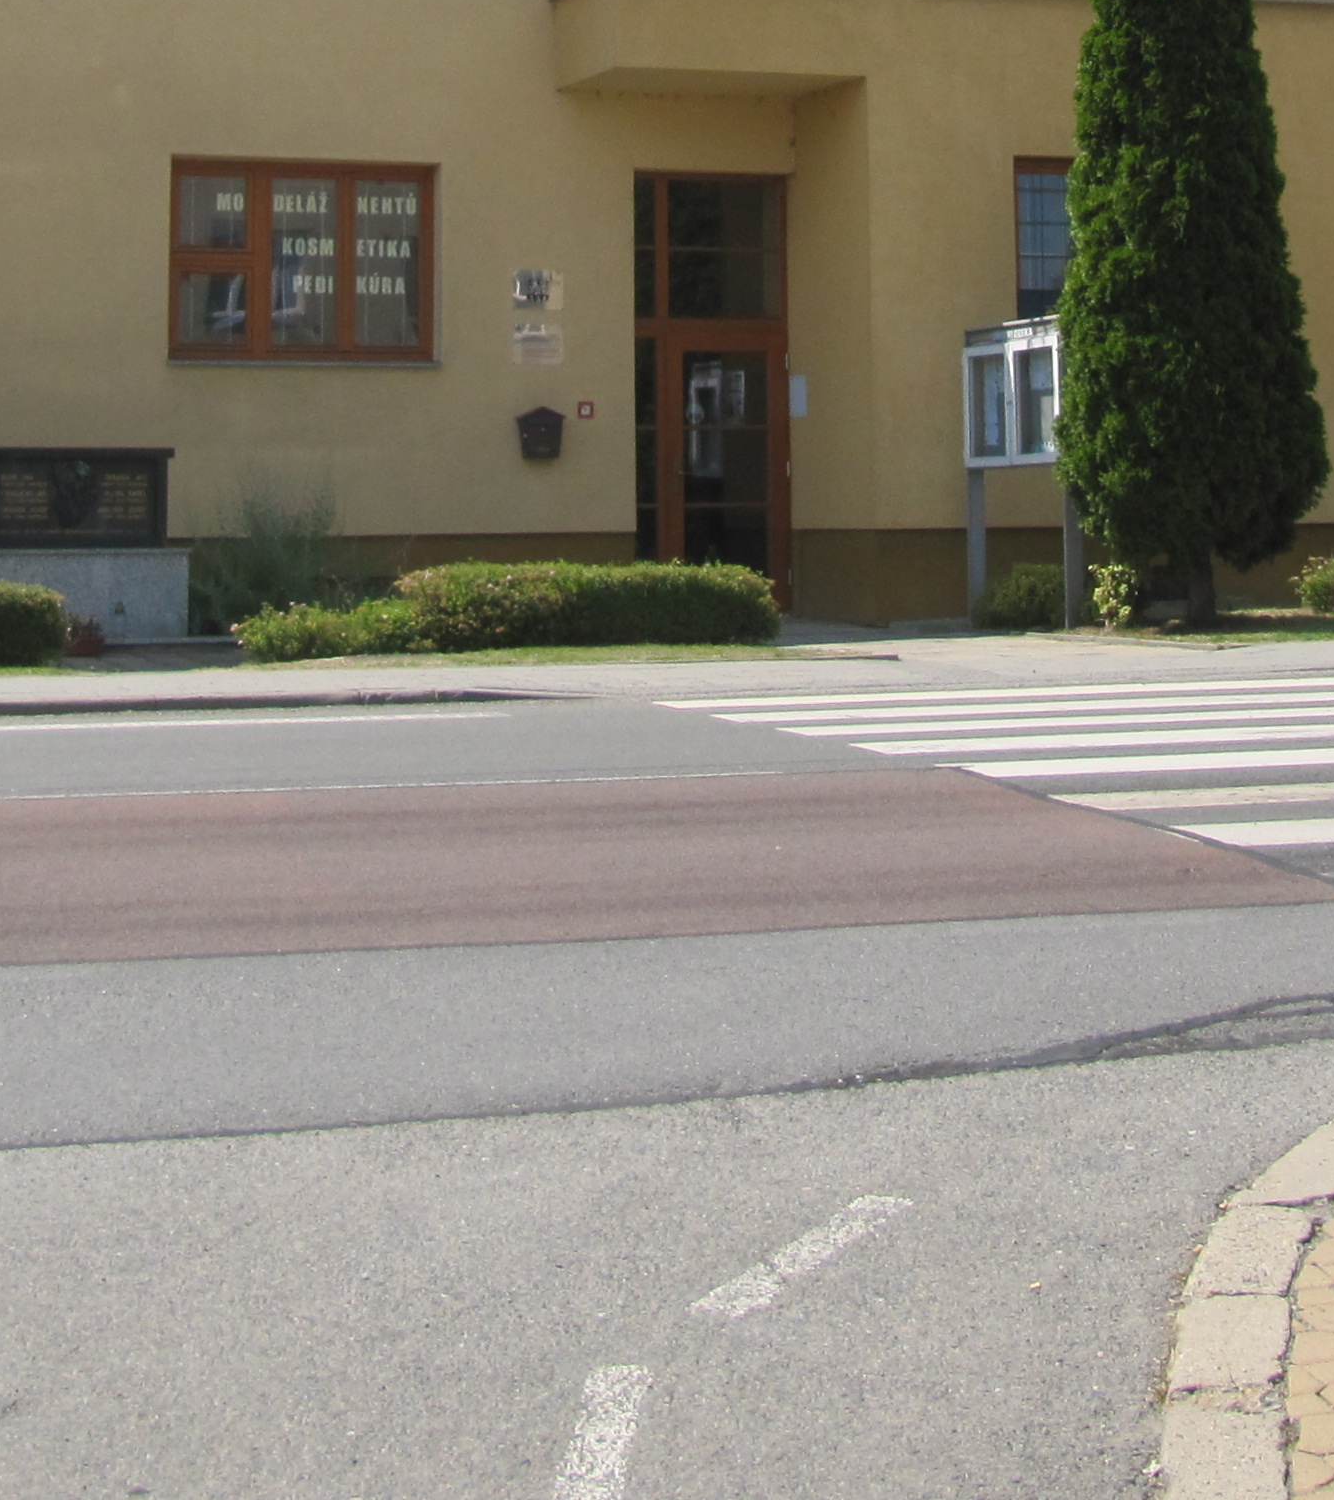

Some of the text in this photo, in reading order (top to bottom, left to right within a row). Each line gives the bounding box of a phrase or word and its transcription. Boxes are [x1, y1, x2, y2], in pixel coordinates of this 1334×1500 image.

[216, 192, 244, 212] MO
[281, 237, 411, 259] KOSM ETIKA
[292, 274, 334, 295] PEDI
